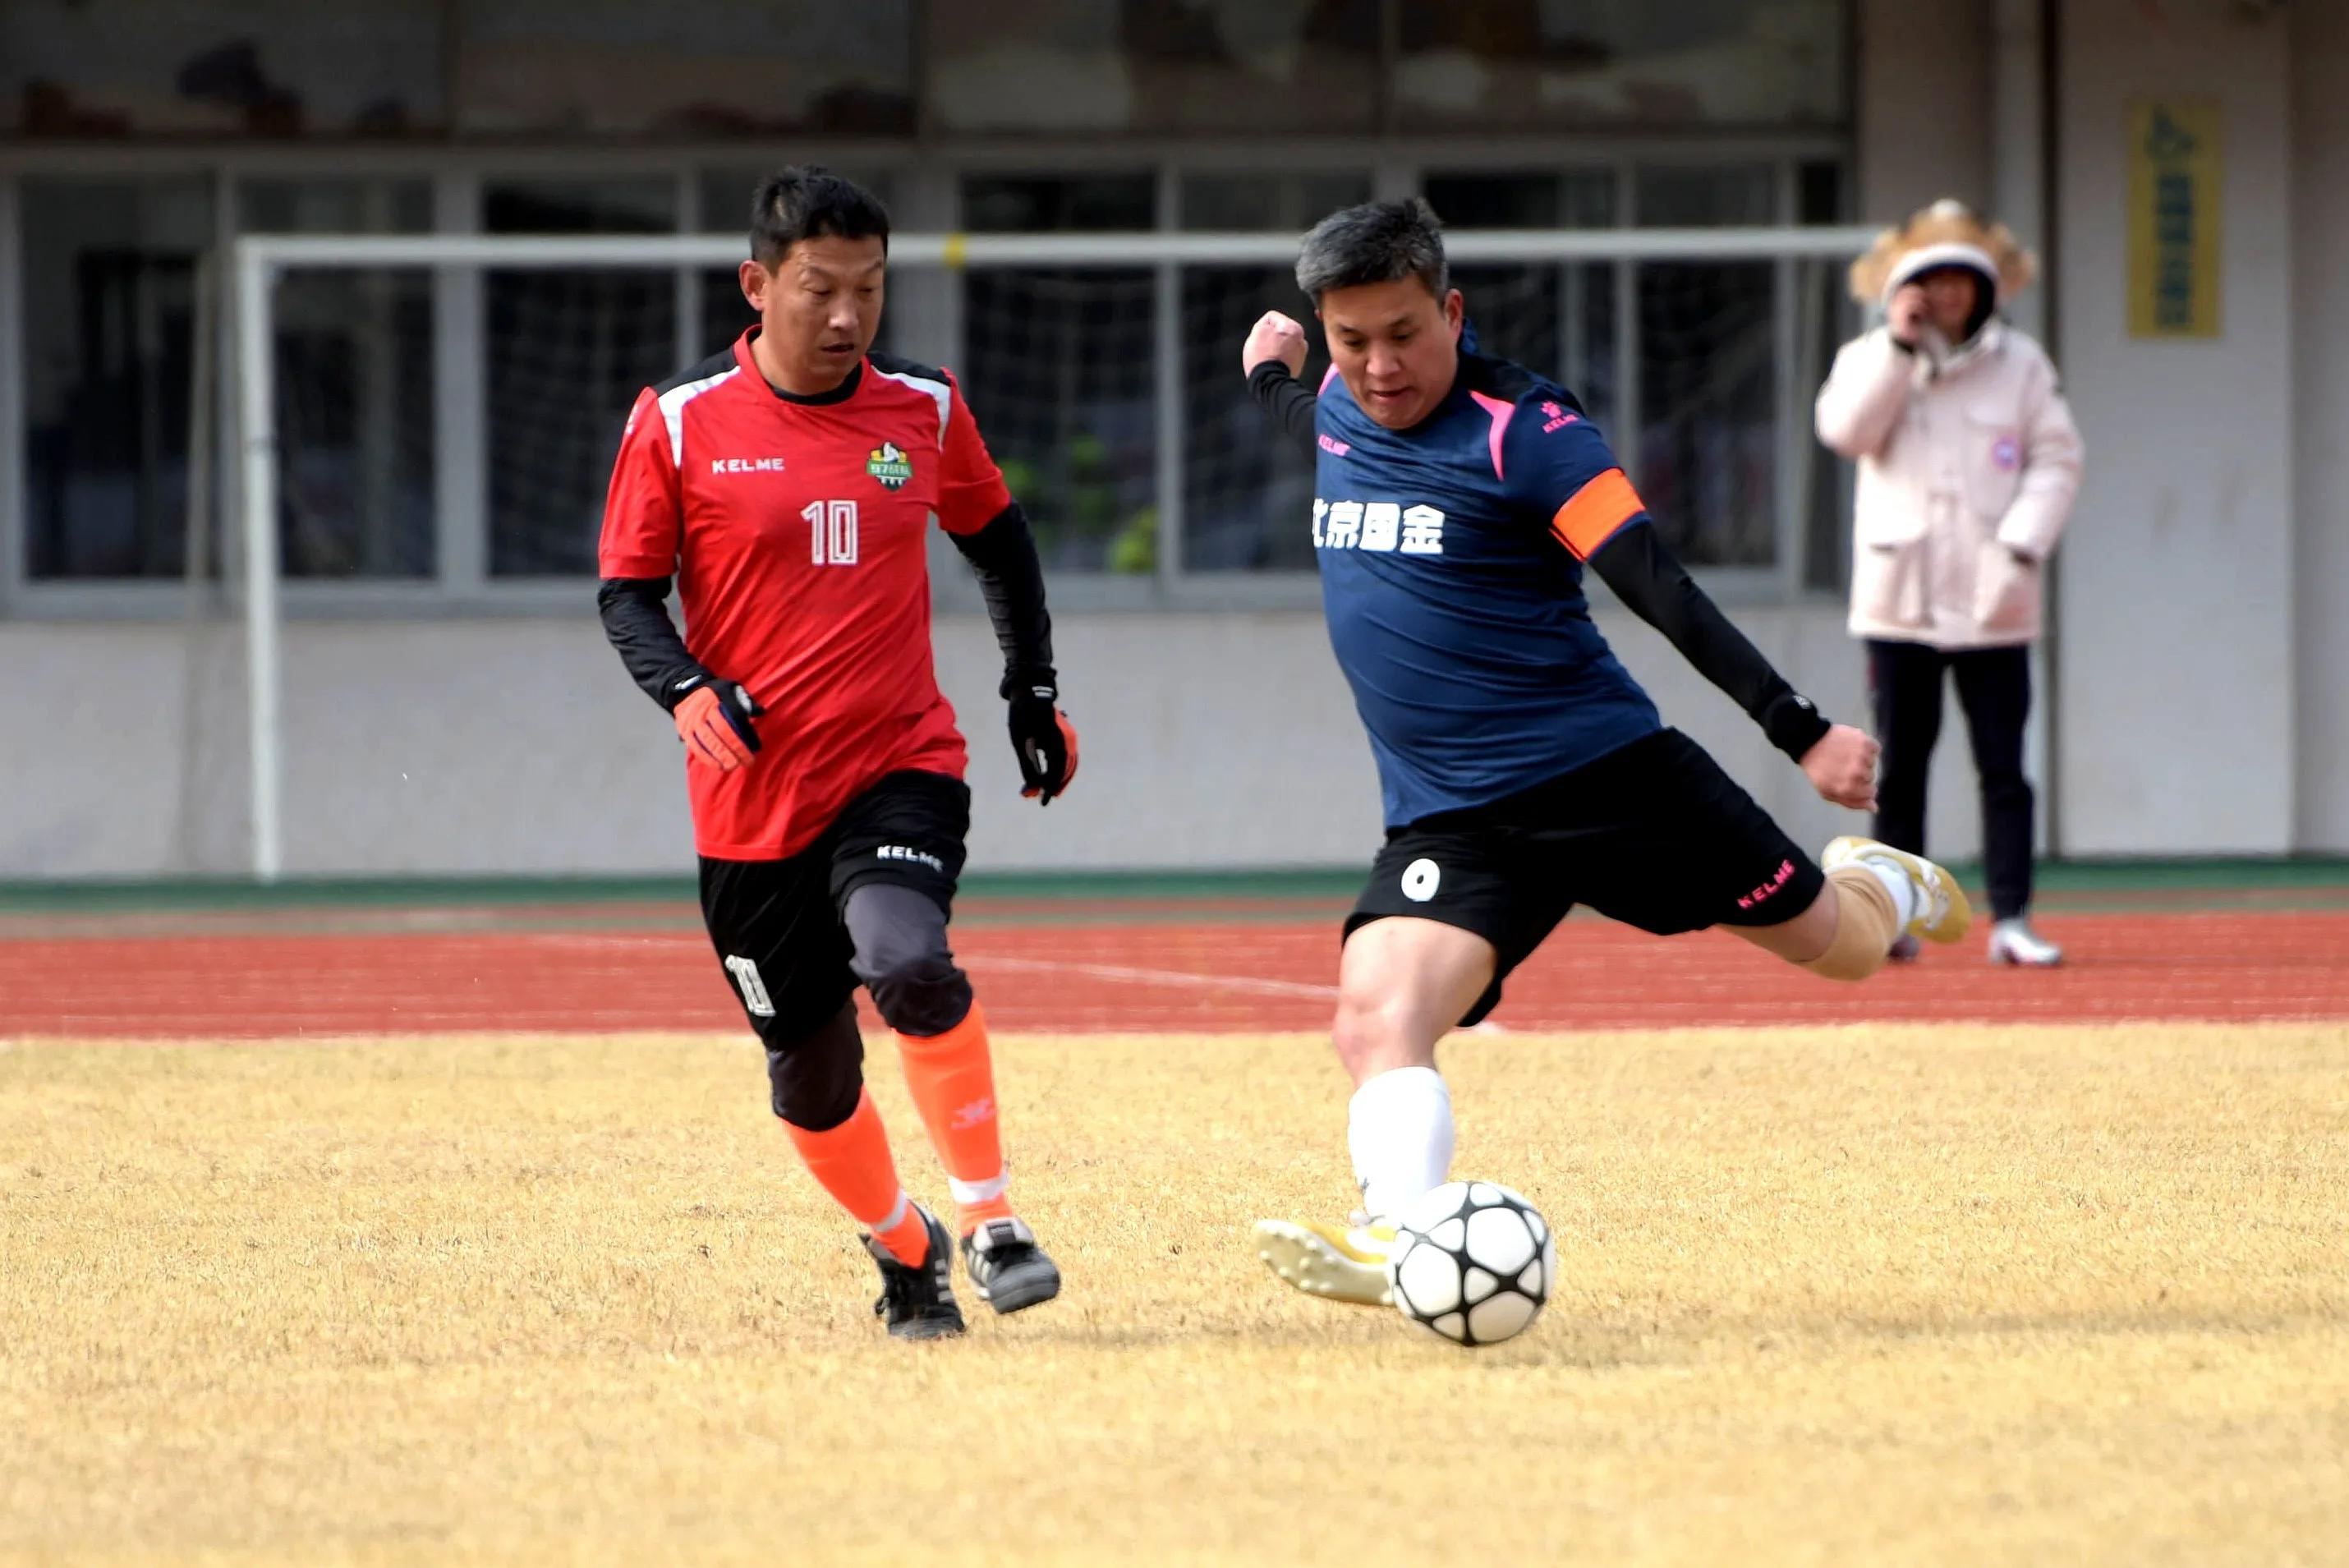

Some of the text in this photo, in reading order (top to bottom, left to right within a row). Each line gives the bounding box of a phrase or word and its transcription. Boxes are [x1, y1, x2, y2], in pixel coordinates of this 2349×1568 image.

[711, 458, 785, 474] KELME
[800, 499, 858, 566] 10
[1401, 858, 1441, 902] 0
[1737, 859, 1795, 909] KELME
